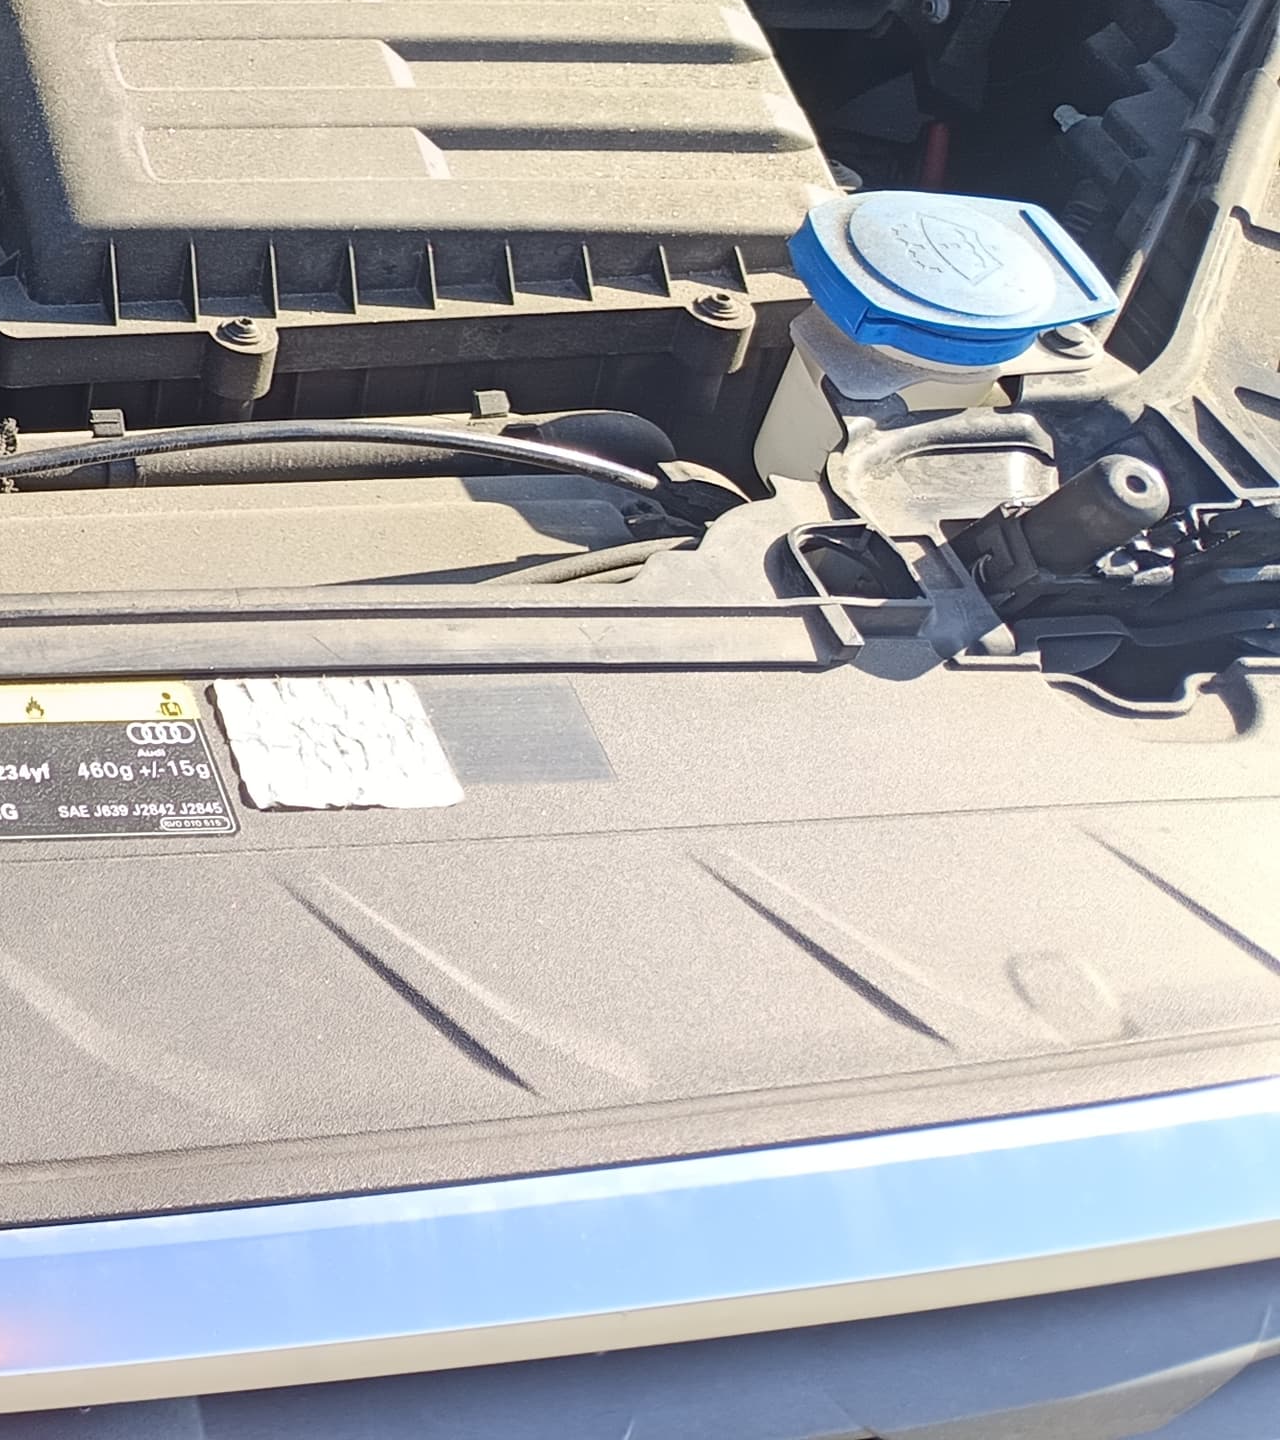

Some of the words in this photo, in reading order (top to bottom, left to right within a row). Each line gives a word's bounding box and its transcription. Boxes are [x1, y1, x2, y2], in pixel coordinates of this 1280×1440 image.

[137, 749, 166, 757] Audi
[78, 761, 134, 781] 460g
[58, 805, 91, 818] SAE
[93, 804, 129, 817] J639
[132, 803, 177, 816] J2842
[180, 802, 223, 815] J2845
